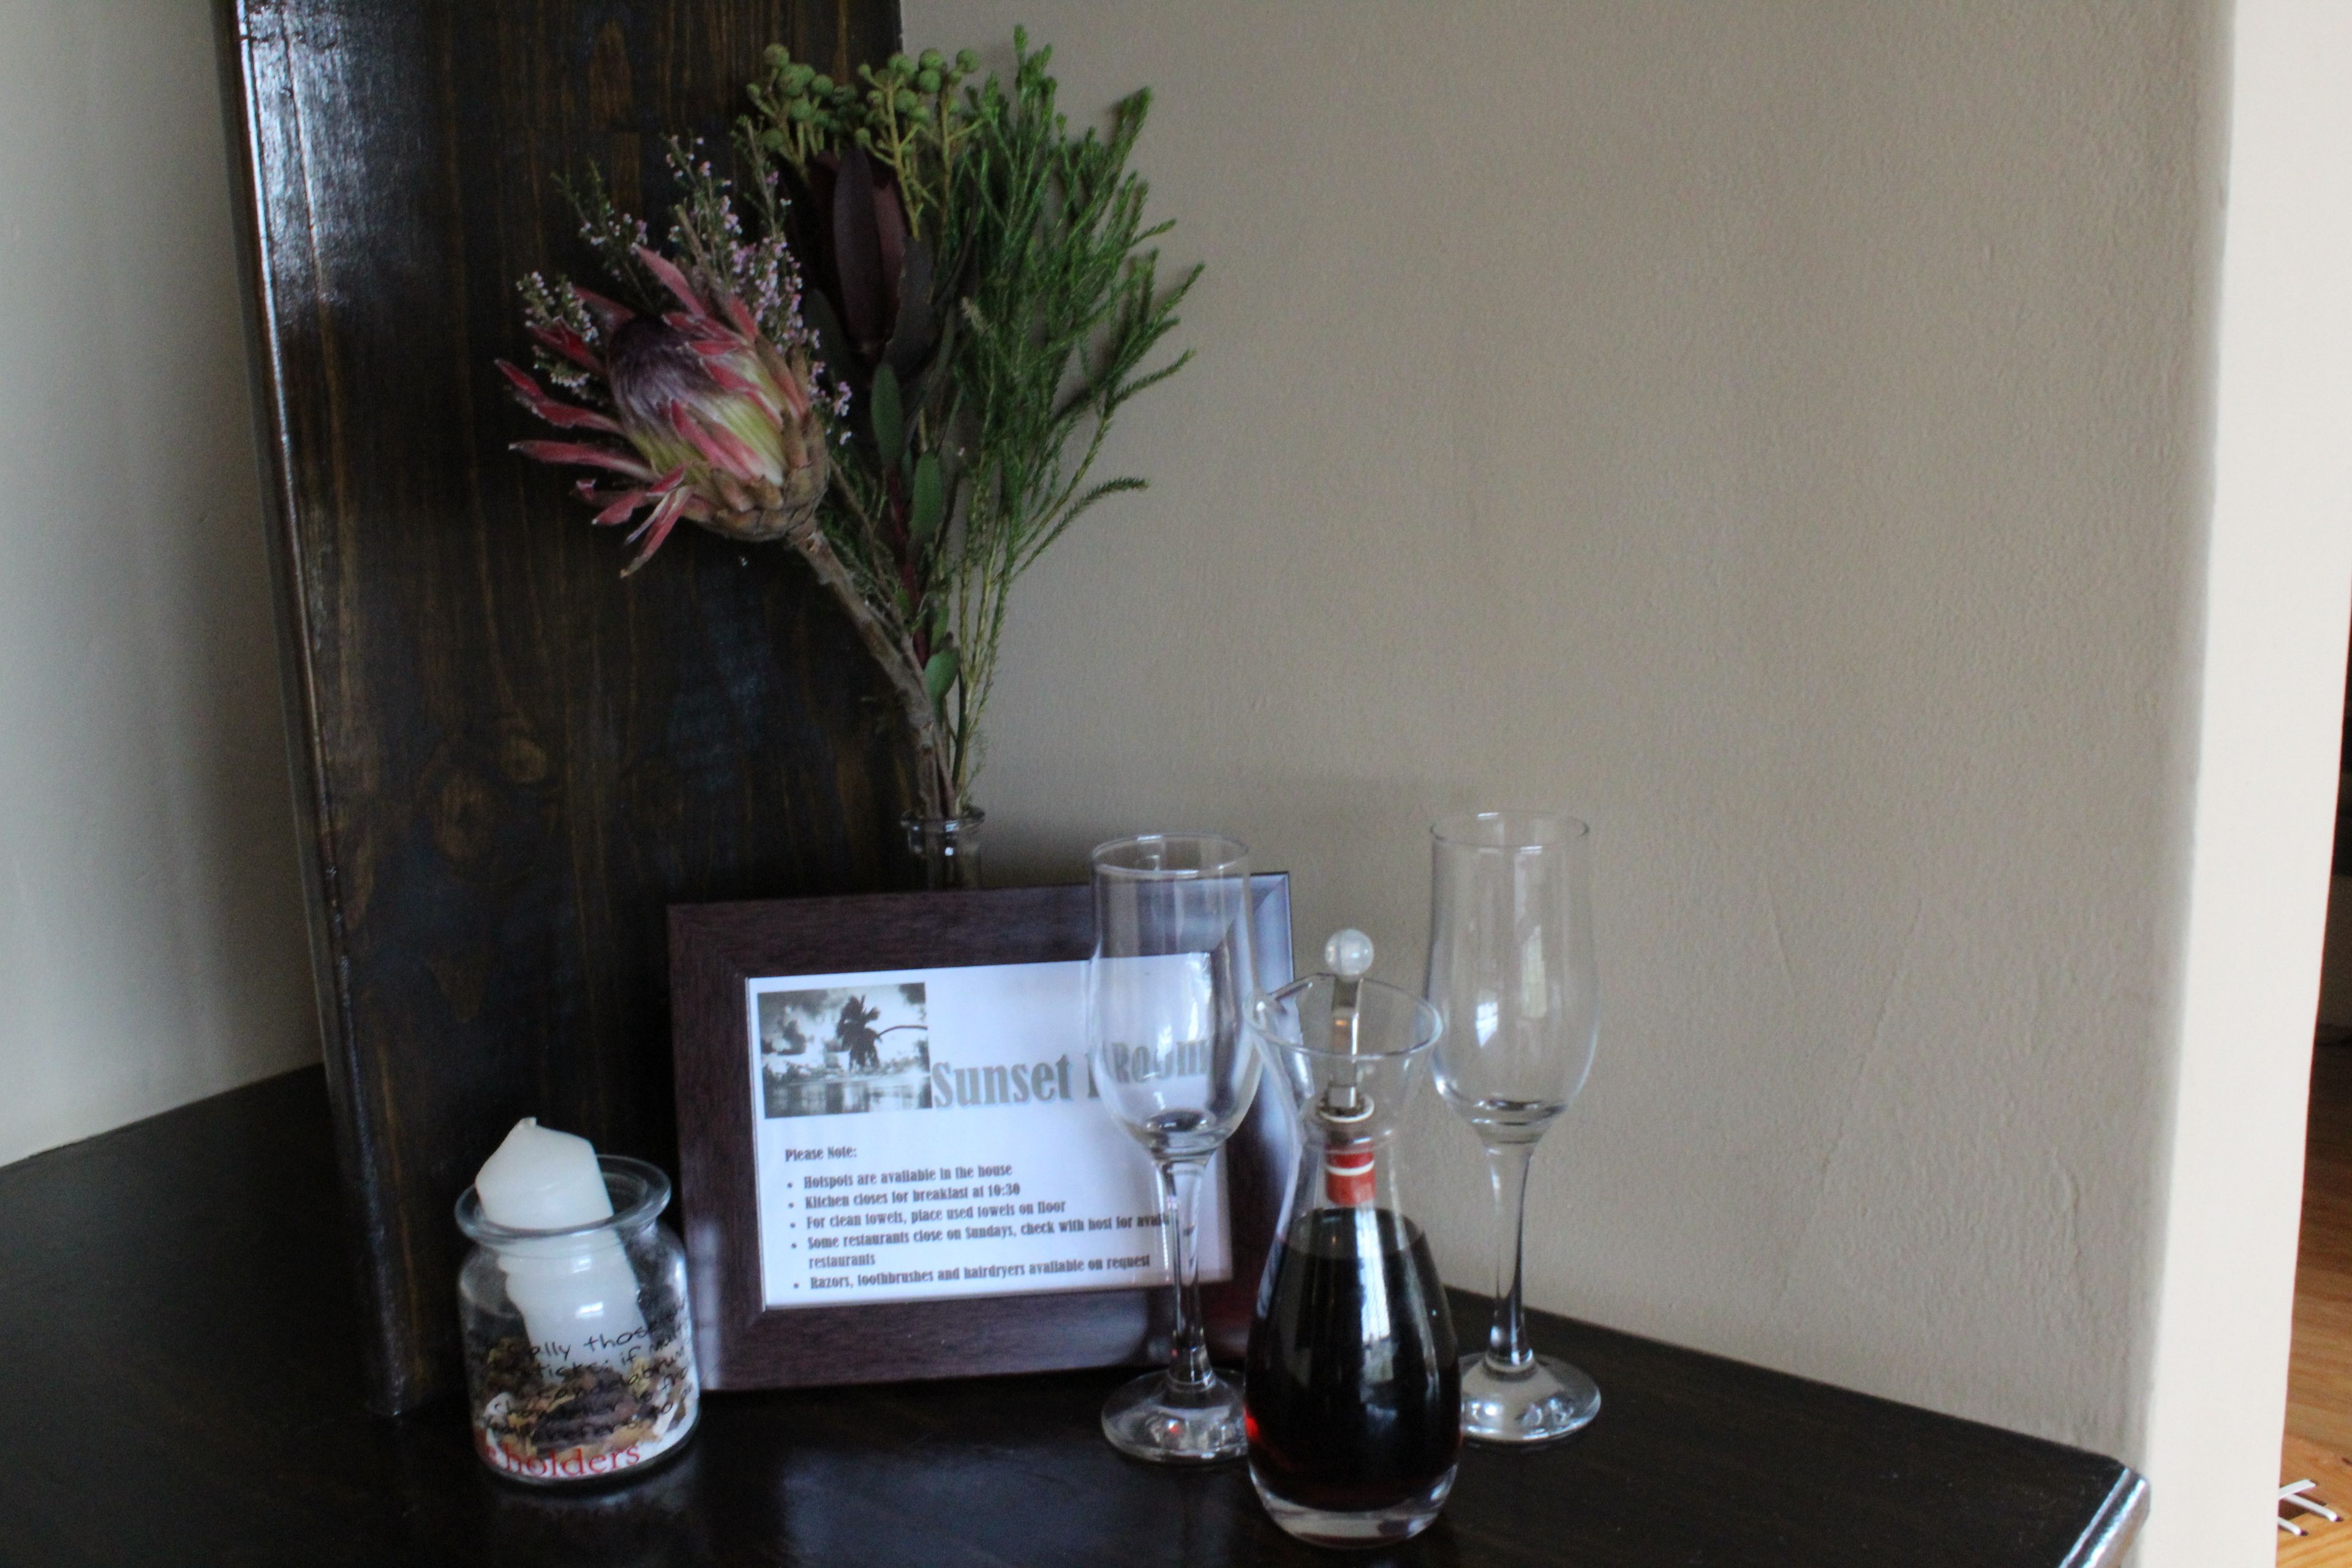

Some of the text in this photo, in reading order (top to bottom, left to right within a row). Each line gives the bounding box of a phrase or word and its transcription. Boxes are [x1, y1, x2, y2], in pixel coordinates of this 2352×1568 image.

[932, 1054, 1071, 1108] Sunset
[785, 1146, 857, 1161] Please Note:
[804, 1164, 1012, 1189] Hotspots are available in the house
[805, 1183, 1020, 1209] Kitchen closes for breakfast at 10:30
[806, 1200, 1066, 1229] For clean towels, place used towels on floor
[808, 1235, 839, 1250] Some
[843, 1231, 910, 1247] restaurants
[913, 1229, 943, 1243] close
[947, 1228, 962, 1240] on
[965, 1224, 1016, 1239] Sundays,
[1020, 1220, 1054, 1236] check
[1058, 1218, 1085, 1233] with
[1088, 1216, 1112, 1231] host
[1116, 1216, 1133, 1230] for
[809, 1253, 876, 1269] restaurants
[810, 1254, 1150, 1290] Razors, toothbrushes and hairdryers available on request
